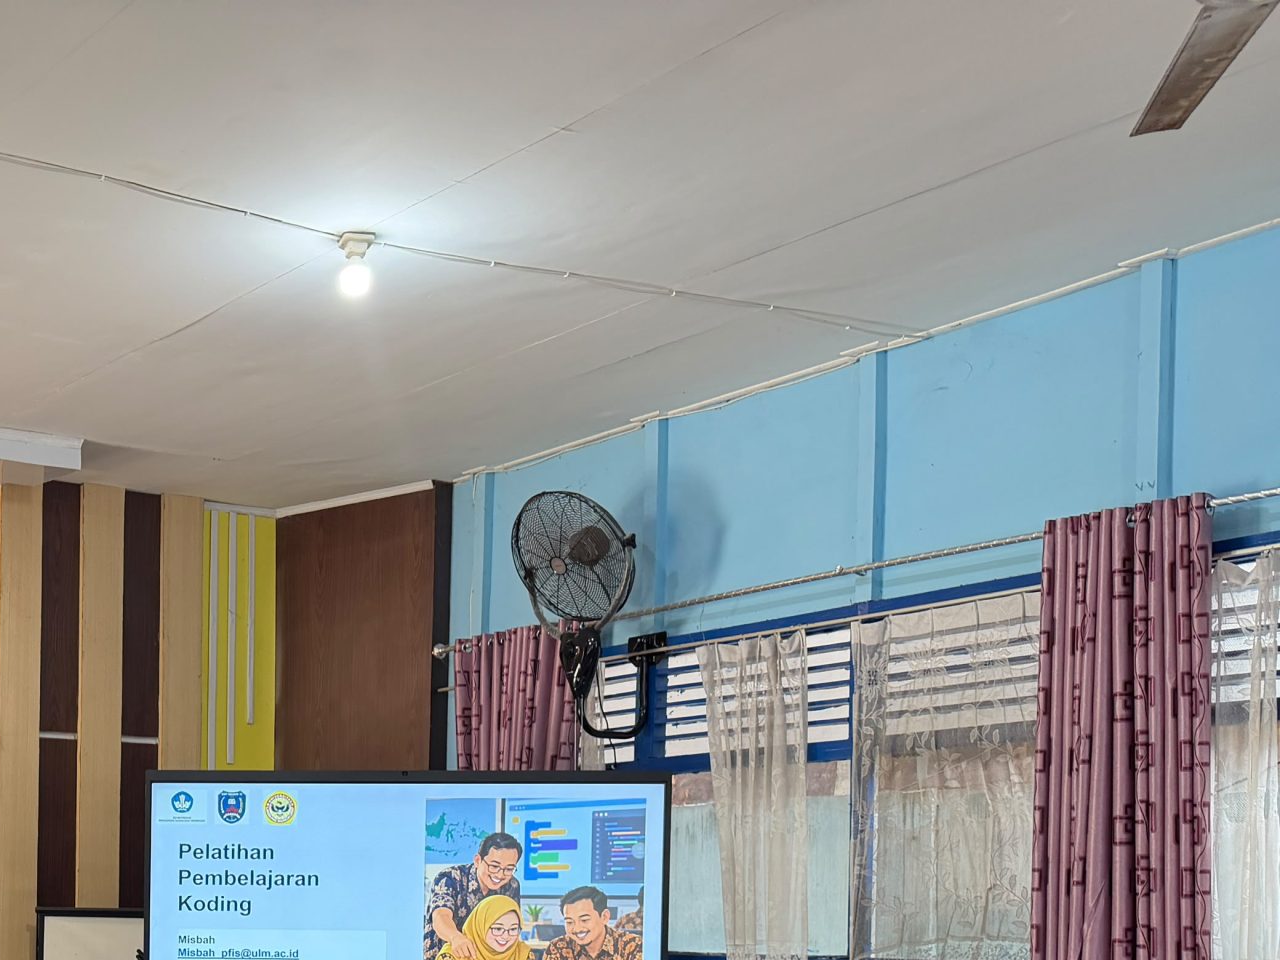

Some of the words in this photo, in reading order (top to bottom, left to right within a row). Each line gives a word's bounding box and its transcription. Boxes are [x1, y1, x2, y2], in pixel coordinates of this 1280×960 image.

[178, 843, 274, 860] Pelatihan
[178, 869, 319, 891] Pembelajaran
[178, 895, 252, 916] Koding
[178, 935, 216, 945] Misbah
